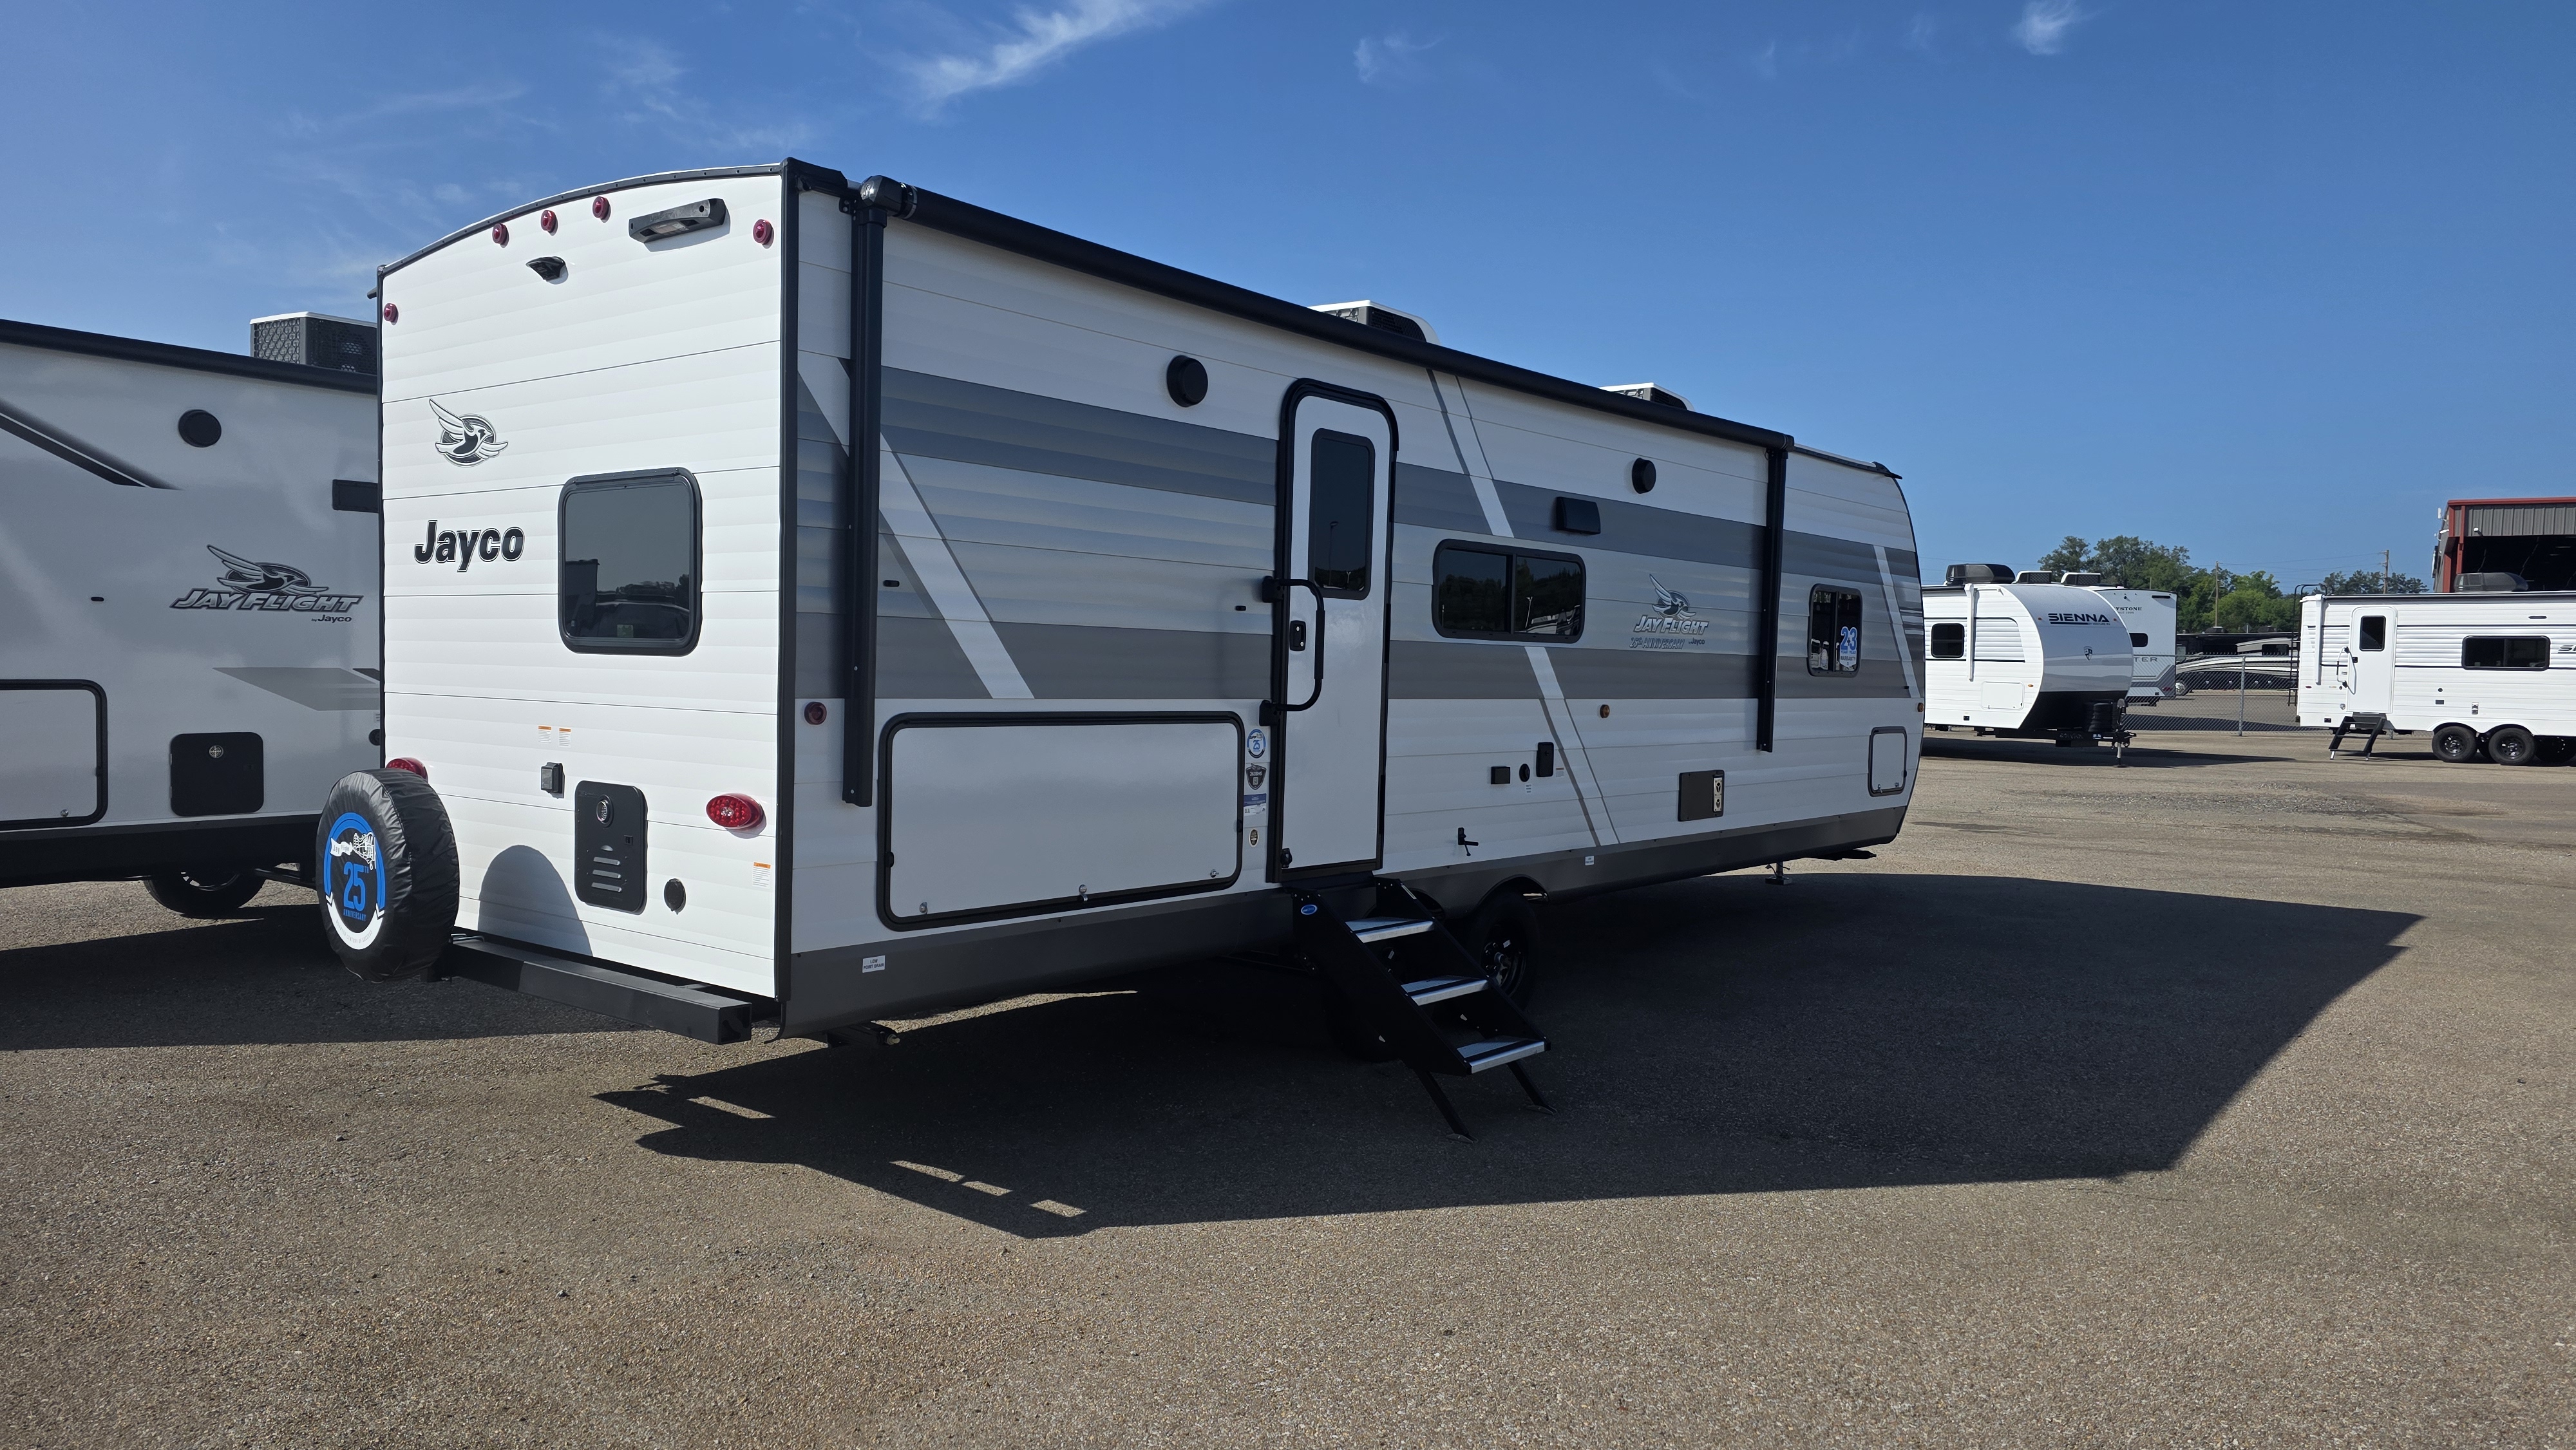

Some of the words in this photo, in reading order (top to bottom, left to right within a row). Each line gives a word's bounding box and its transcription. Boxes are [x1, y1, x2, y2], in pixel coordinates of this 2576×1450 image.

[413, 520, 525, 572] Jayco
[169, 588, 245, 610] JAY
[236, 592, 364, 612] FLIGHT
[317, 614, 352, 623] Jayco
[2048, 613, 2110, 623] SIENNA
[1634, 615, 1662, 632] JAY
[1660, 617, 1710, 635] FLIGHT
[1629, 637, 1643, 648] 25th
[1642, 637, 1685, 649] ANNIVERSARY
[1690, 637, 1705, 646] Jayco
[344, 862, 365, 911] 25
[343, 909, 366, 922] ANNIVERSARY
